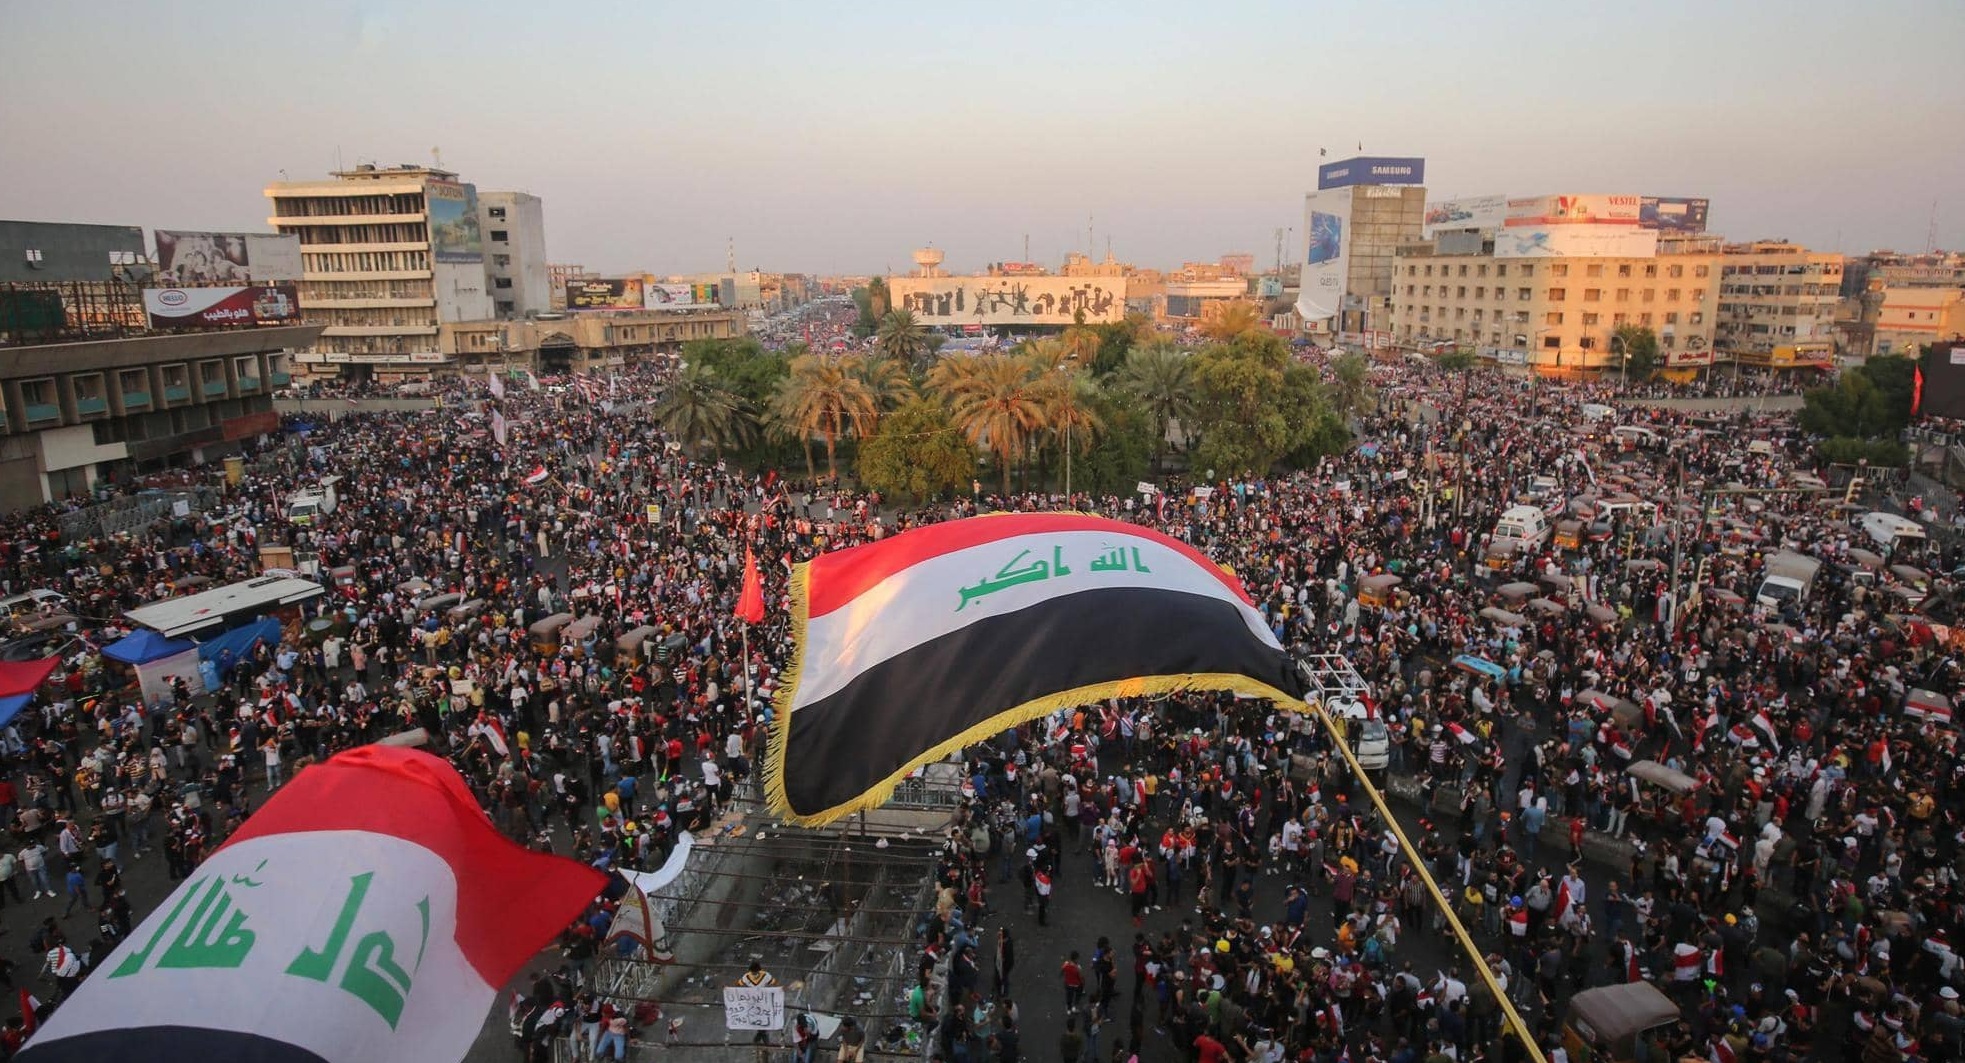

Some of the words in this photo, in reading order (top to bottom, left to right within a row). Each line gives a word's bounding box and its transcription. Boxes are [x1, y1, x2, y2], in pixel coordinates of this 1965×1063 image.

[1372, 166, 1412, 175] SAMSUNG
[1608, 196, 1638, 206] VESTEL
[1090, 542, 1151, 573] الله
